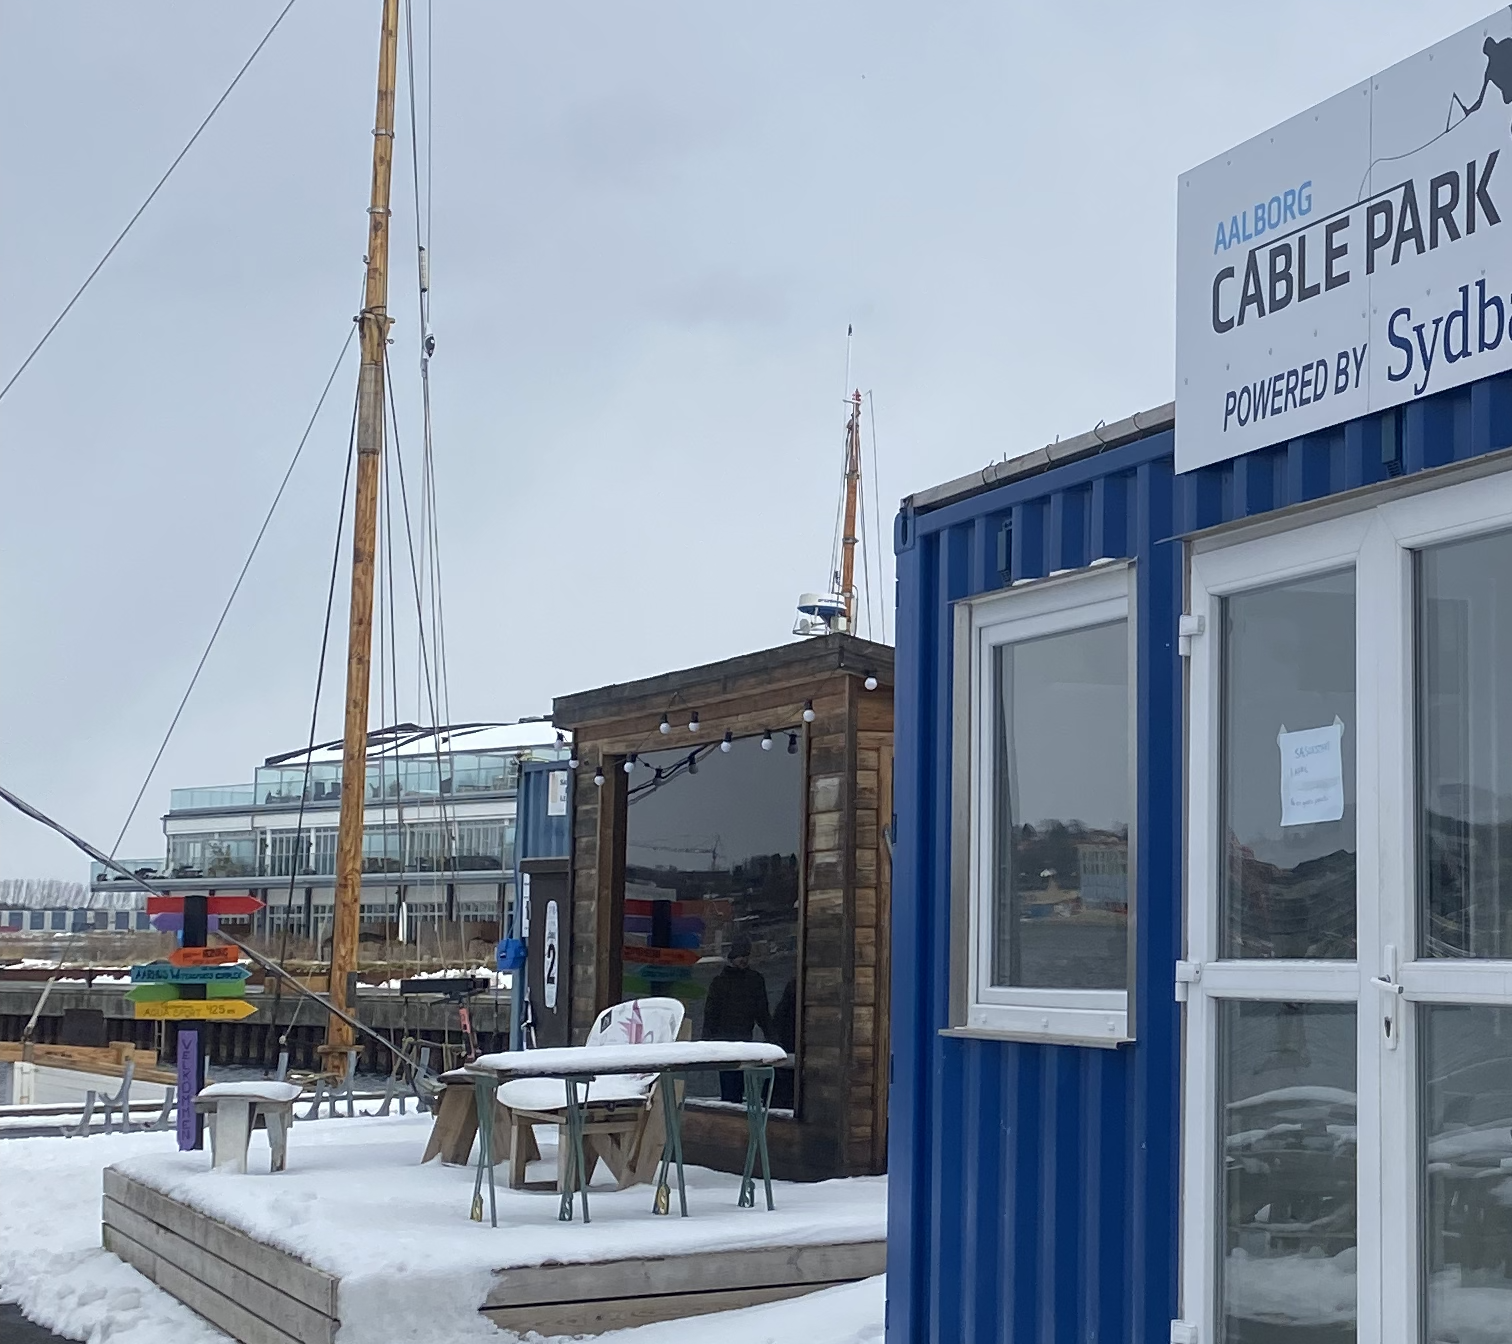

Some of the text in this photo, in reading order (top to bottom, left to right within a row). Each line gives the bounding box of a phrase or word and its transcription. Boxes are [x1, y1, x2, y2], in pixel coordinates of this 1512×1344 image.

[1212, 149, 1502, 335] CABLE PARK
[1213, 181, 1313, 255] AALBORG
[1223, 359, 1328, 432] POWERED
[1333, 343, 1368, 396] BY
[546, 943, 556, 985] 2
[181, 1039, 193, 1141] VELKOMMEN
